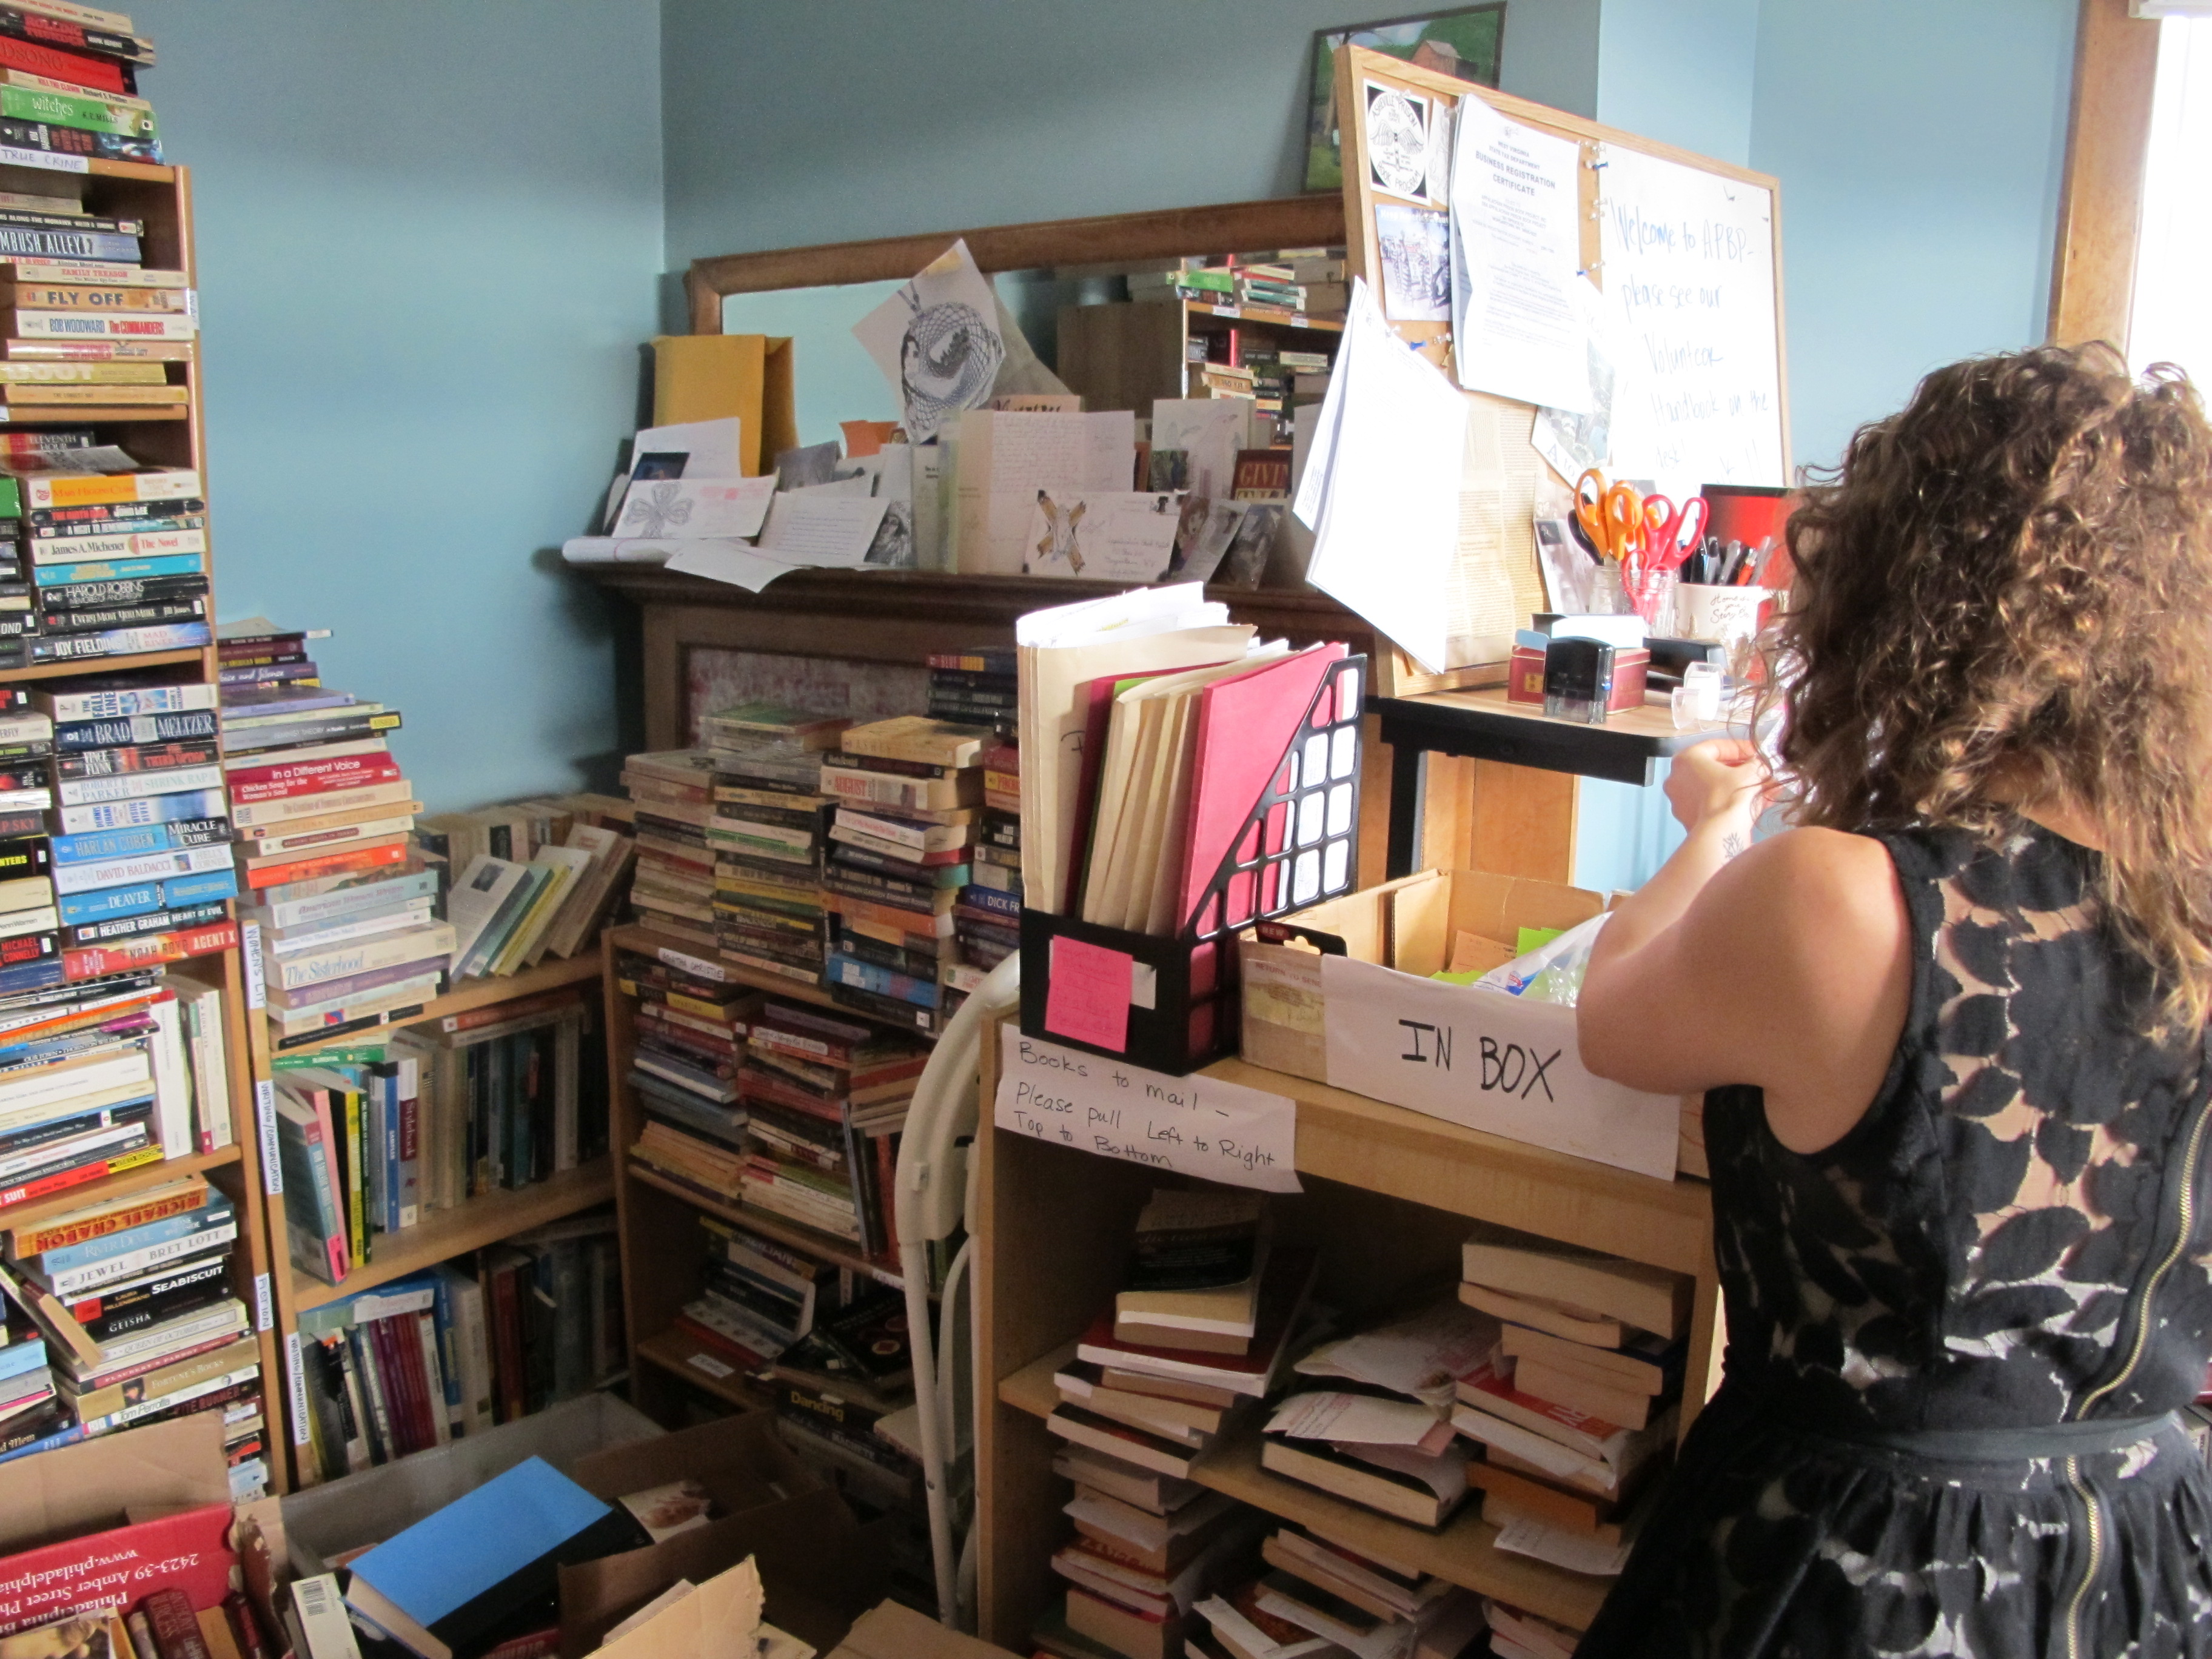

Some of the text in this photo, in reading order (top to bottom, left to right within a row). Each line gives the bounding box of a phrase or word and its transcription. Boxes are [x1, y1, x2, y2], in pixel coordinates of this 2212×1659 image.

[32, 96, 73, 116] witches
[1372, 95, 1418, 127] ASHEVILLE PRISON
[1498, 141, 1530, 158] WEST VIRGINIA
[1476, 150, 1556, 189] BUSINESS REGISTRATION
[1510, 155, 1541, 170] DEPARTMENT
[1377, 162, 1421, 192] BOOK PROGRAM
[1493, 173, 1535, 196] CERTIFICATE
[1610, 196, 1697, 255] Welcome to
[47, 234, 81, 255] ALLEY
[48, 291, 124, 305] FLY OFF
[1621, 273, 1723, 324] please see our
[50, 318, 105, 333] BOB WOODWARD
[120, 322, 164, 335] COMMANDERS
[1651, 389, 1769, 429] Handbook on the
[1547, 443, 1575, 477] A to
[52, 545, 78, 554] James
[141, 540, 155, 549] The
[158, 538, 178, 547] Novel
[65, 584, 106, 597] HAROLD
[55, 641, 72, 657] JOY
[95, 715, 214, 744] BRAD MELTZER
[293, 763, 332, 777] Different
[333, 759, 361, 772] Voice
[82, 788, 131, 803] PARKER
[11, 819, 36, 831] SKY
[168, 820, 216, 836] MIRACLE
[179, 833, 211, 846] CURE
[96, 859, 172, 880] DAVID BALDACCI
[107, 890, 152, 908] DEAVER
[988, 895, 1007, 910] DICK
[171, 905, 224, 923] HEART EVIL
[98, 914, 170, 937] HEATHER GRAHAM
[1262, 926, 1285, 937] NEW
[1, 937, 39, 951] MICHAEL
[193, 930, 236, 950] AGENT X
[3, 948, 39, 963] CONNELLY
[285, 965, 304, 984] The
[1255, 961, 1286, 976] RETURN
[1019, 1041, 1088, 1077] Books
[1112, 1071, 1130, 1088] to
[1399, 1019, 1561, 1103] IN BOX
[404, 1101, 416, 1157] Stylebook
[1015, 1081, 1276, 1171] Please Left to Right
[1013, 1110, 1173, 1168] Top to Bottom
[4, 1188, 26, 1201] SUIT
[36, 1195, 201, 1252] MICHAEL CHABON
[79, 1231, 220, 1284] JEWEL BRET LOTT
[151, 1265, 224, 1295] SEABISCUIT
[258, 1278, 270, 1328] FICTION
[108, 1311, 152, 1333] GEISHA
[138, 1398, 170, 1415] Perrotta
[790, 1390, 845, 1423] Dancing
[134, 1552, 199, 1581] 2423-39
[77, 1566, 130, 1596] Amber
[25, 1584, 73, 1607] Street
